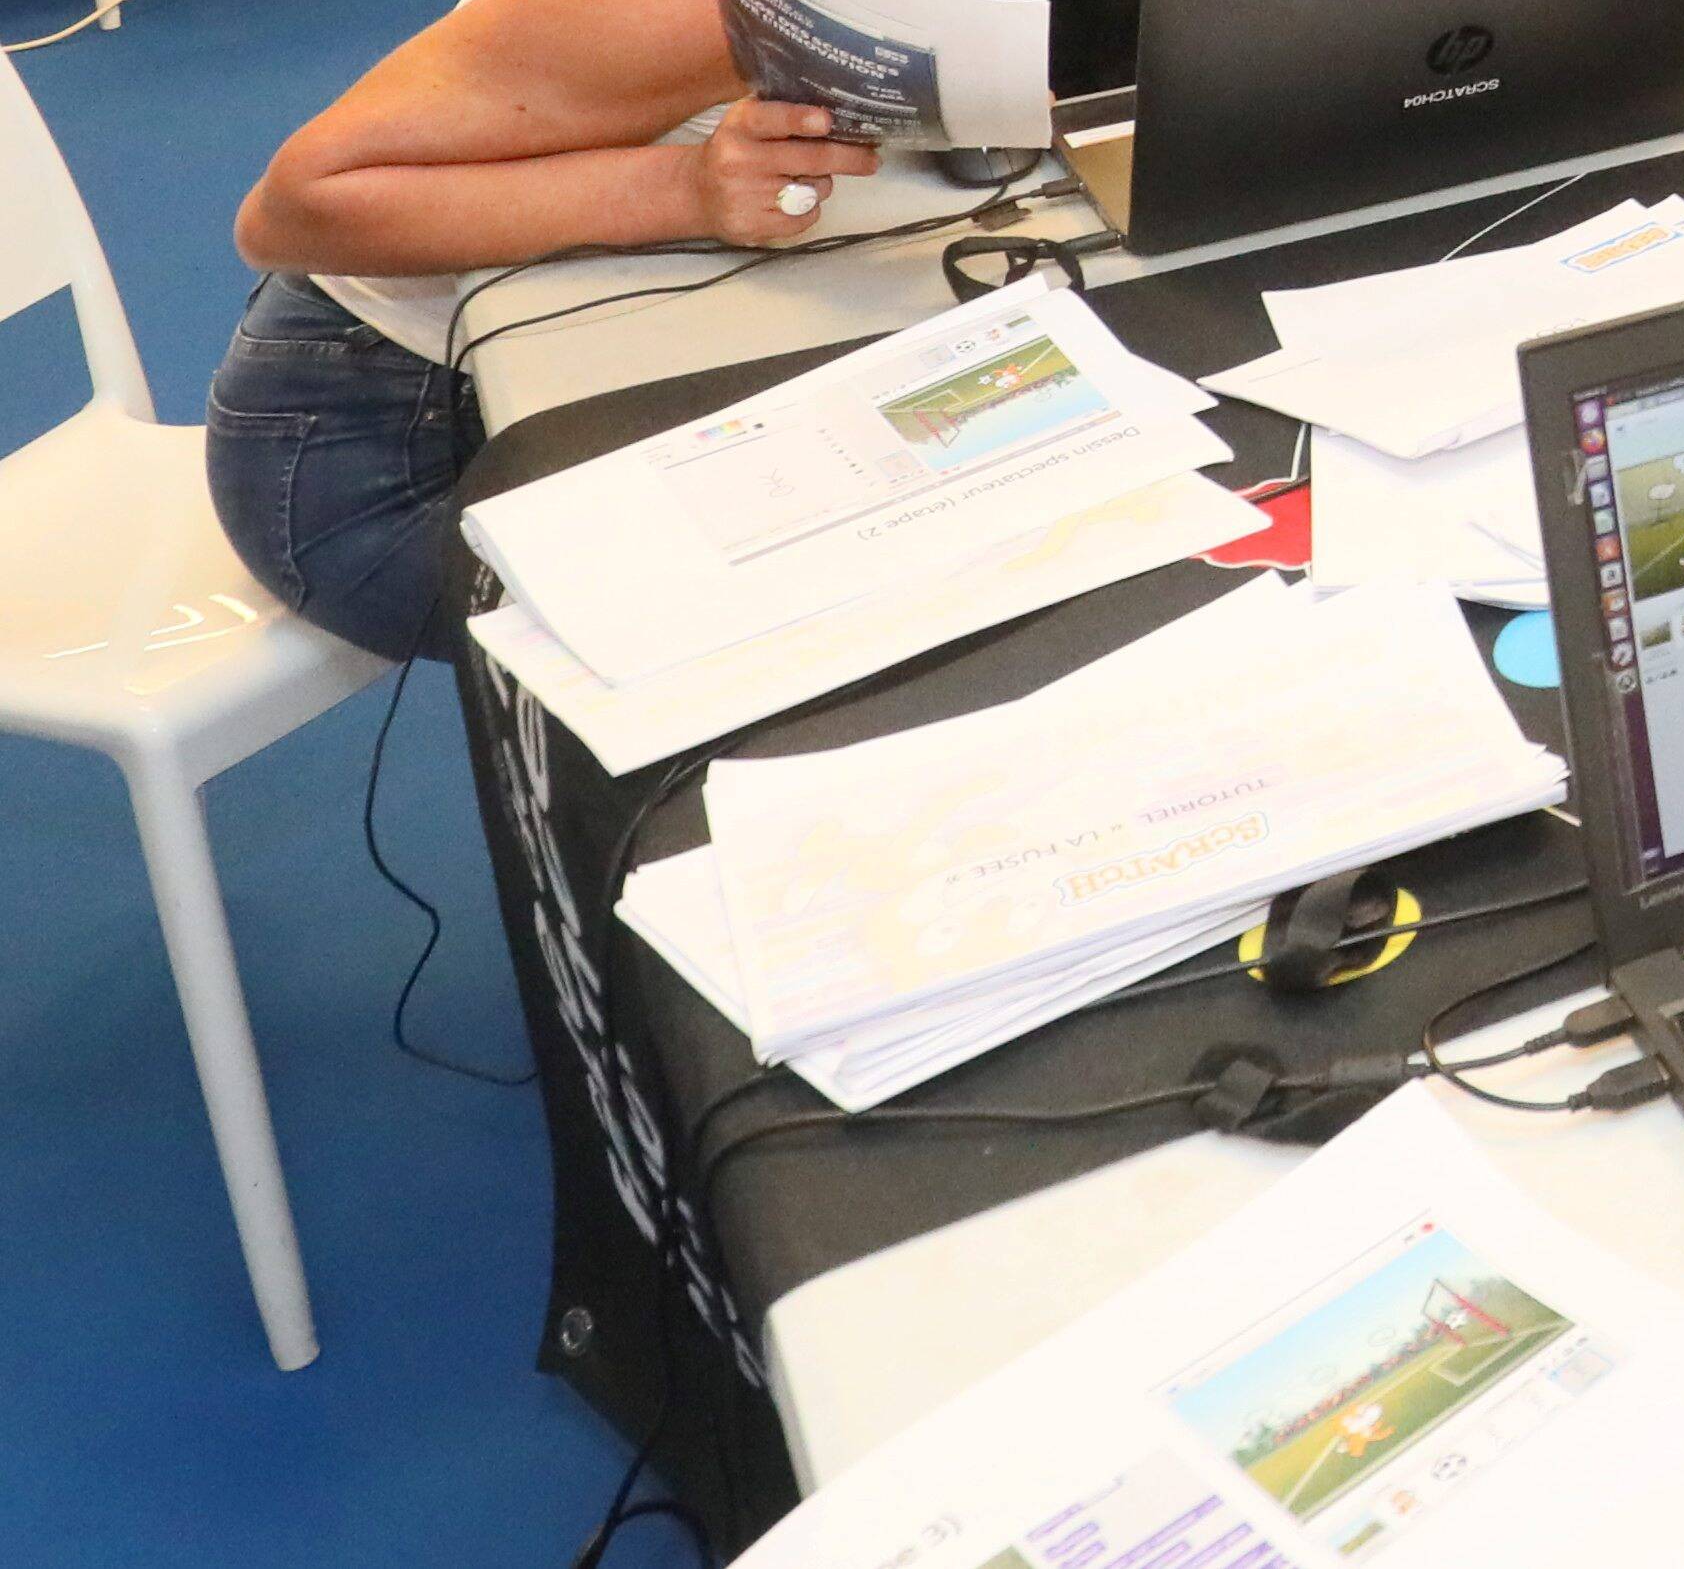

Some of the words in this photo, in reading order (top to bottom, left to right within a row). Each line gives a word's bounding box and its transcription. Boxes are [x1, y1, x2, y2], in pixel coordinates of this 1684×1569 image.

[1404, 78, 1500, 108] SCRATCH04
[1071, 425, 1142, 459] Dessin
[960, 452, 1070, 503] spectateur
[855, 518, 883, 542] 2)
[883, 495, 957, 531] (étape
[1137, 777, 1268, 826] TUTORIEL
[1065, 829, 1101, 848] LA
